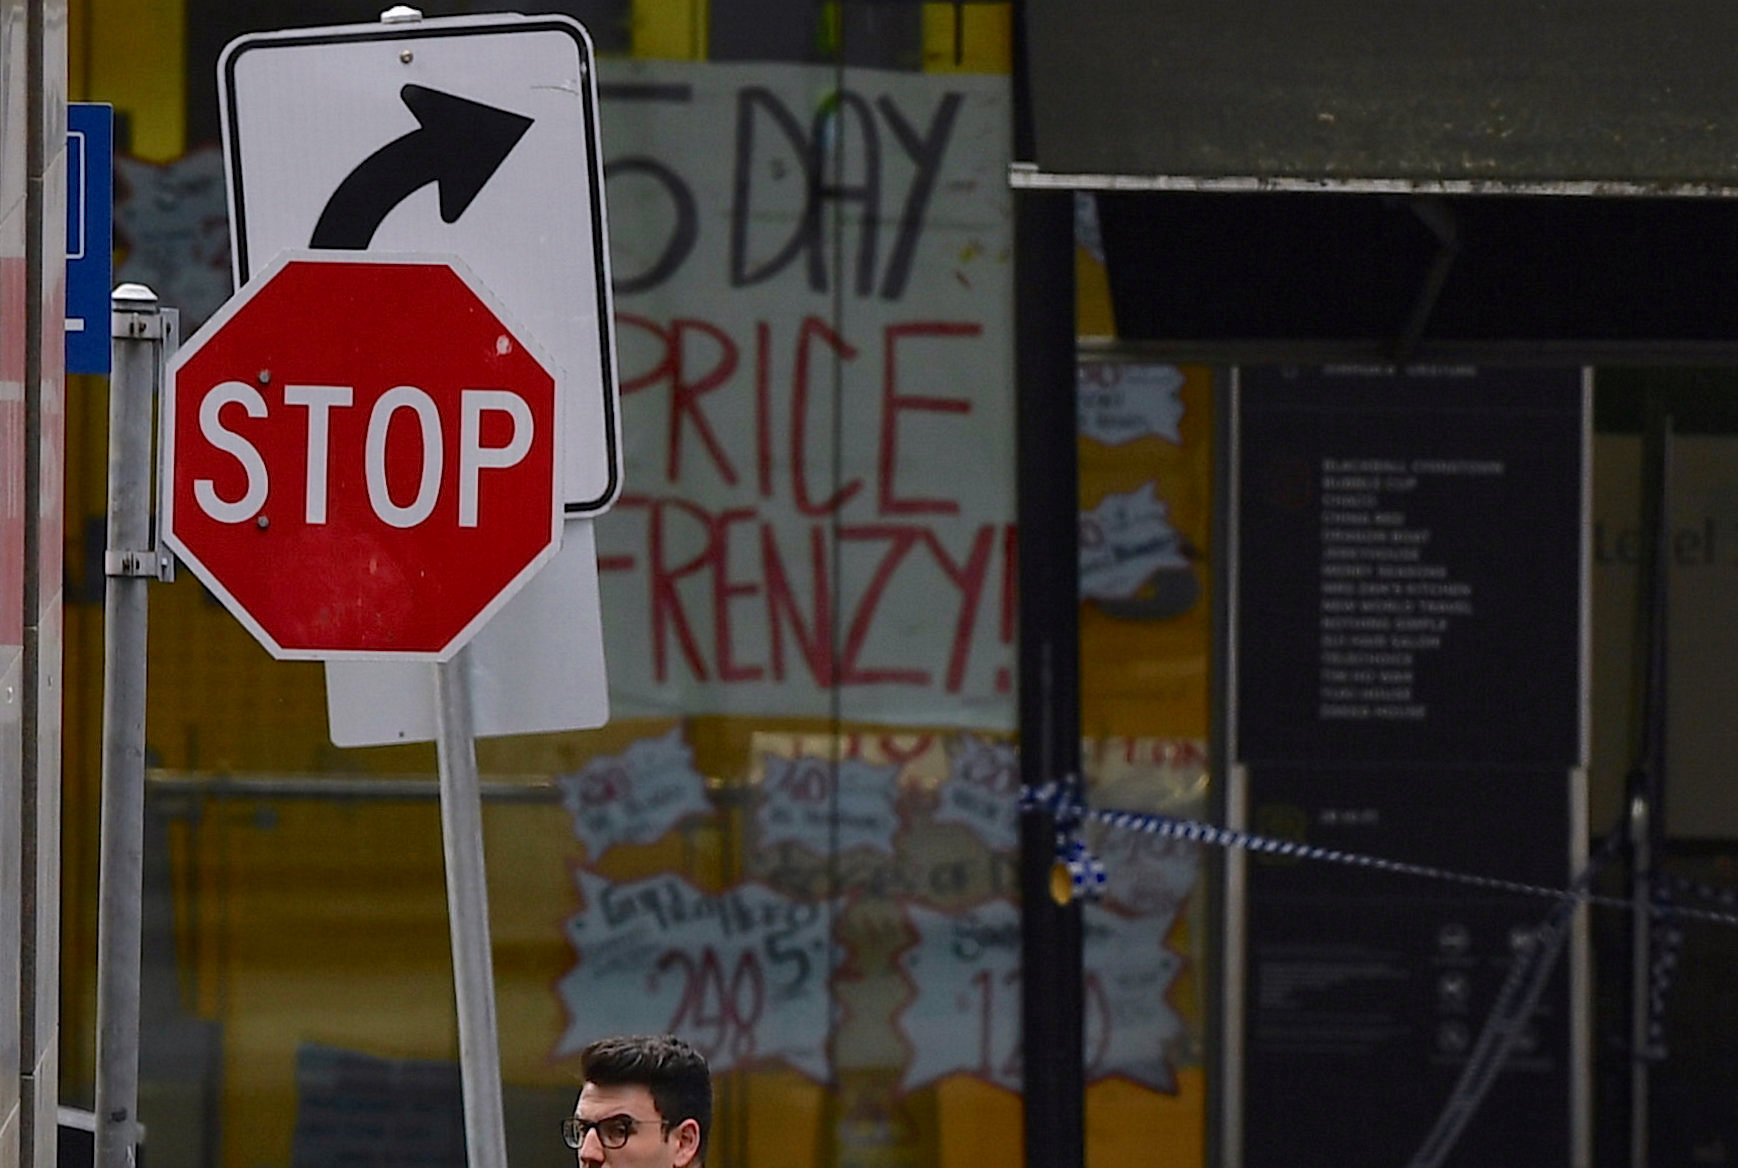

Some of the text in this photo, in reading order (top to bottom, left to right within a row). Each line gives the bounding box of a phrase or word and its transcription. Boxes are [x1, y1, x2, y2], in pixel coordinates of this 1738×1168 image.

[732, 85, 966, 302] DAY
[193, 380, 535, 529] STOP
[1594, 519, 1715, 566] Leel
